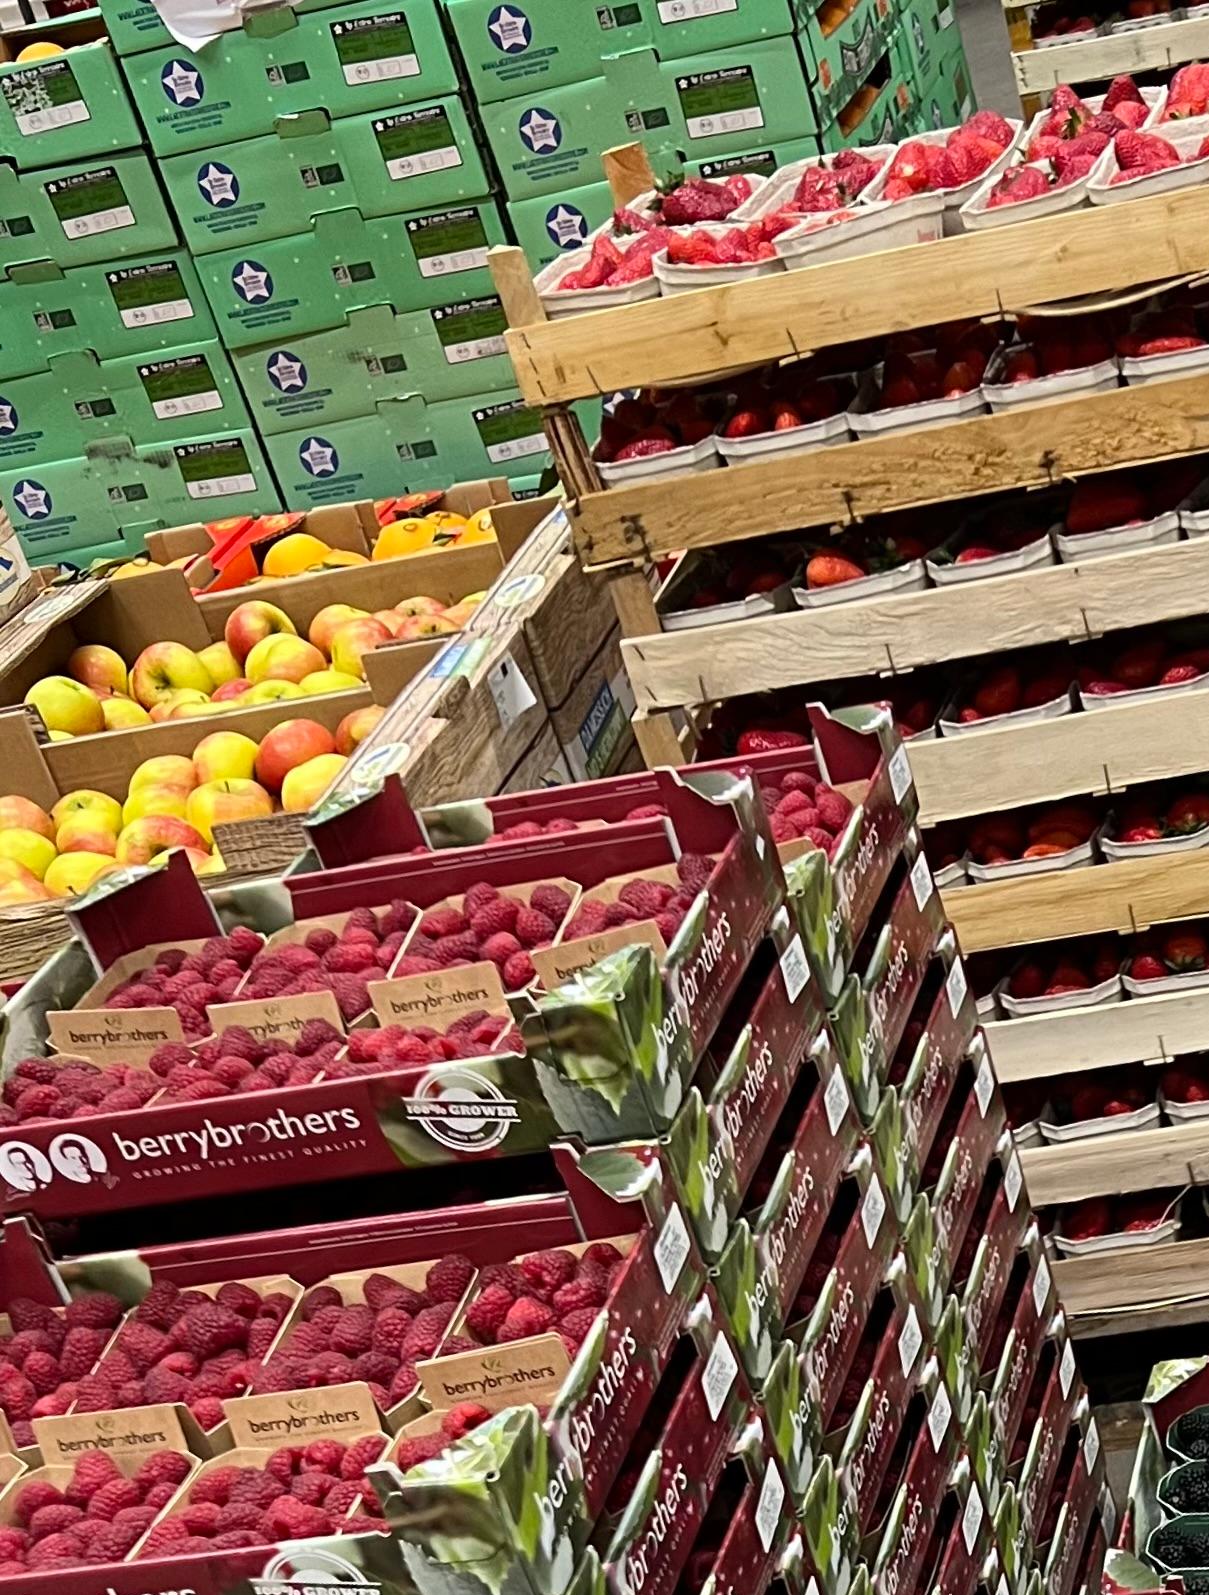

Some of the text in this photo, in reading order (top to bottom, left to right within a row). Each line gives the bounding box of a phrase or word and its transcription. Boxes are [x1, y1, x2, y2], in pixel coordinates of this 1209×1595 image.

[391, 988, 489, 1014] berrybrothers
[446, 1106, 520, 1118] GROWER
[113, 1106, 360, 1160] berrybrothers
[442, 1365, 556, 1396] berrybrothers
[247, 1409, 360, 1434] berrybrothers
[56, 1431, 167, 1454] berrybrothers
